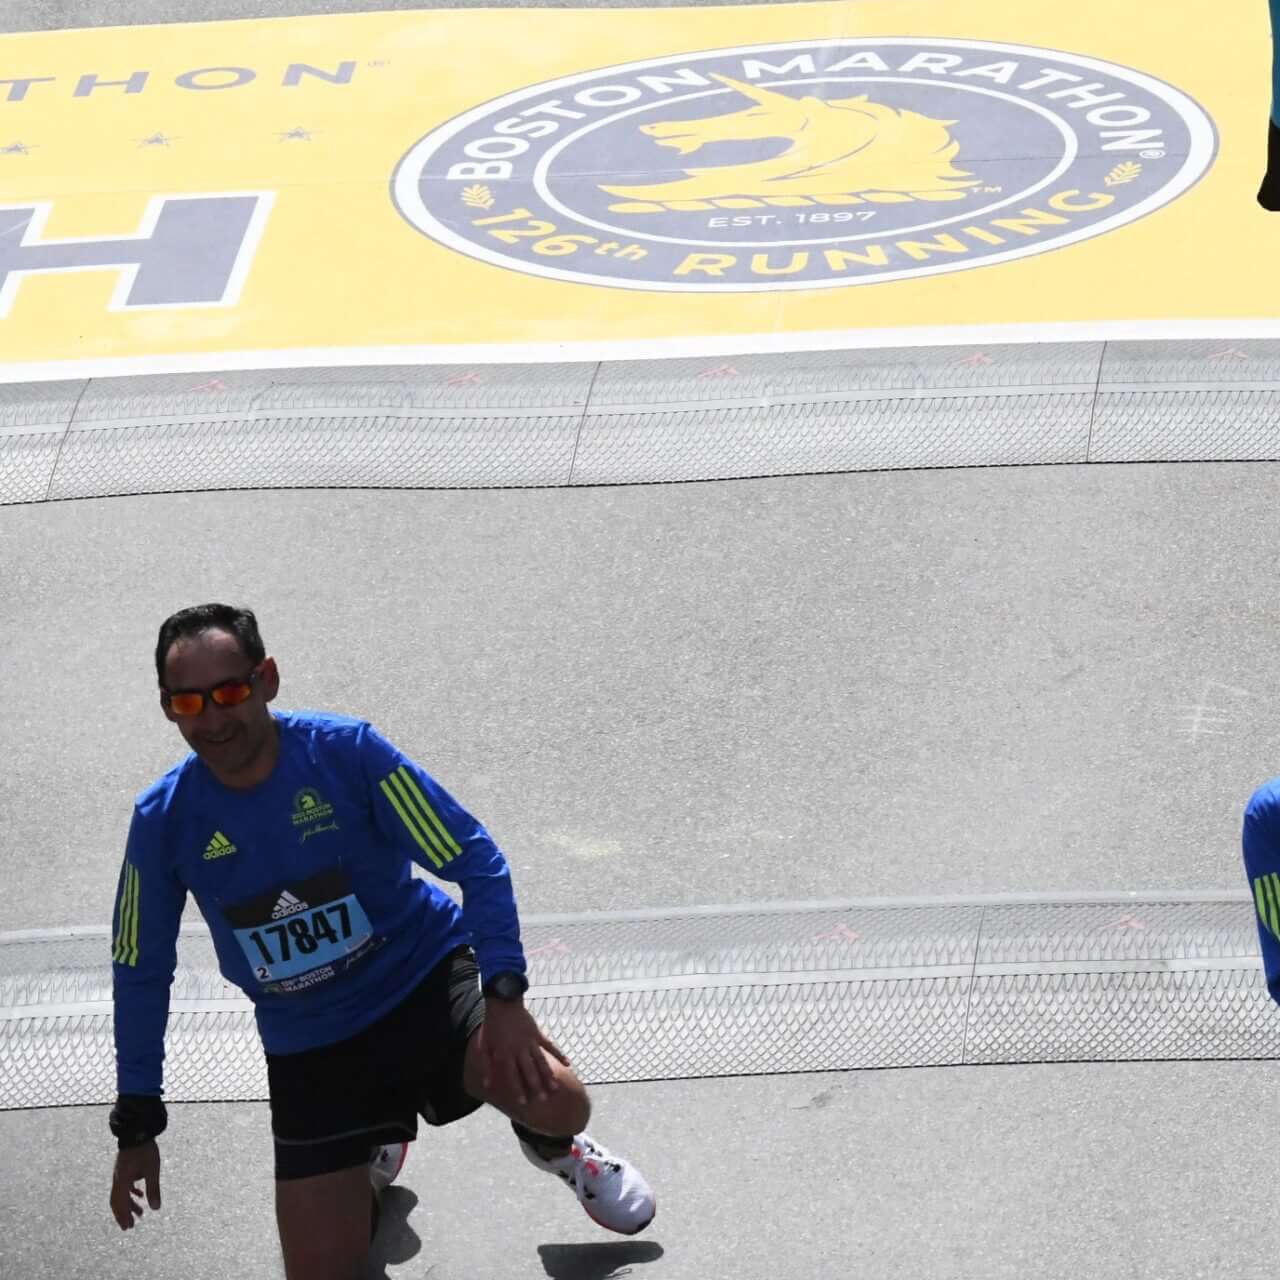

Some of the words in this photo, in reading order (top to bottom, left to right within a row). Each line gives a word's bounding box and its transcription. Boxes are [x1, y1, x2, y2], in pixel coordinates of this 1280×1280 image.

[446, 67, 712, 180] BOSTON
[743, 51, 1164, 152] MARATHON
[708, 216, 782, 229] EST.
[798, 211, 877, 224] 1897
[472, 207, 649, 262] 126th
[673, 189, 1116, 276] RUNNING
[203, 844, 237, 860] adidas
[272, 901, 309, 920] adidas
[249, 903, 353, 966] 17847
[256, 967, 269, 979] 2
[285, 971, 336, 992] MARATHON
